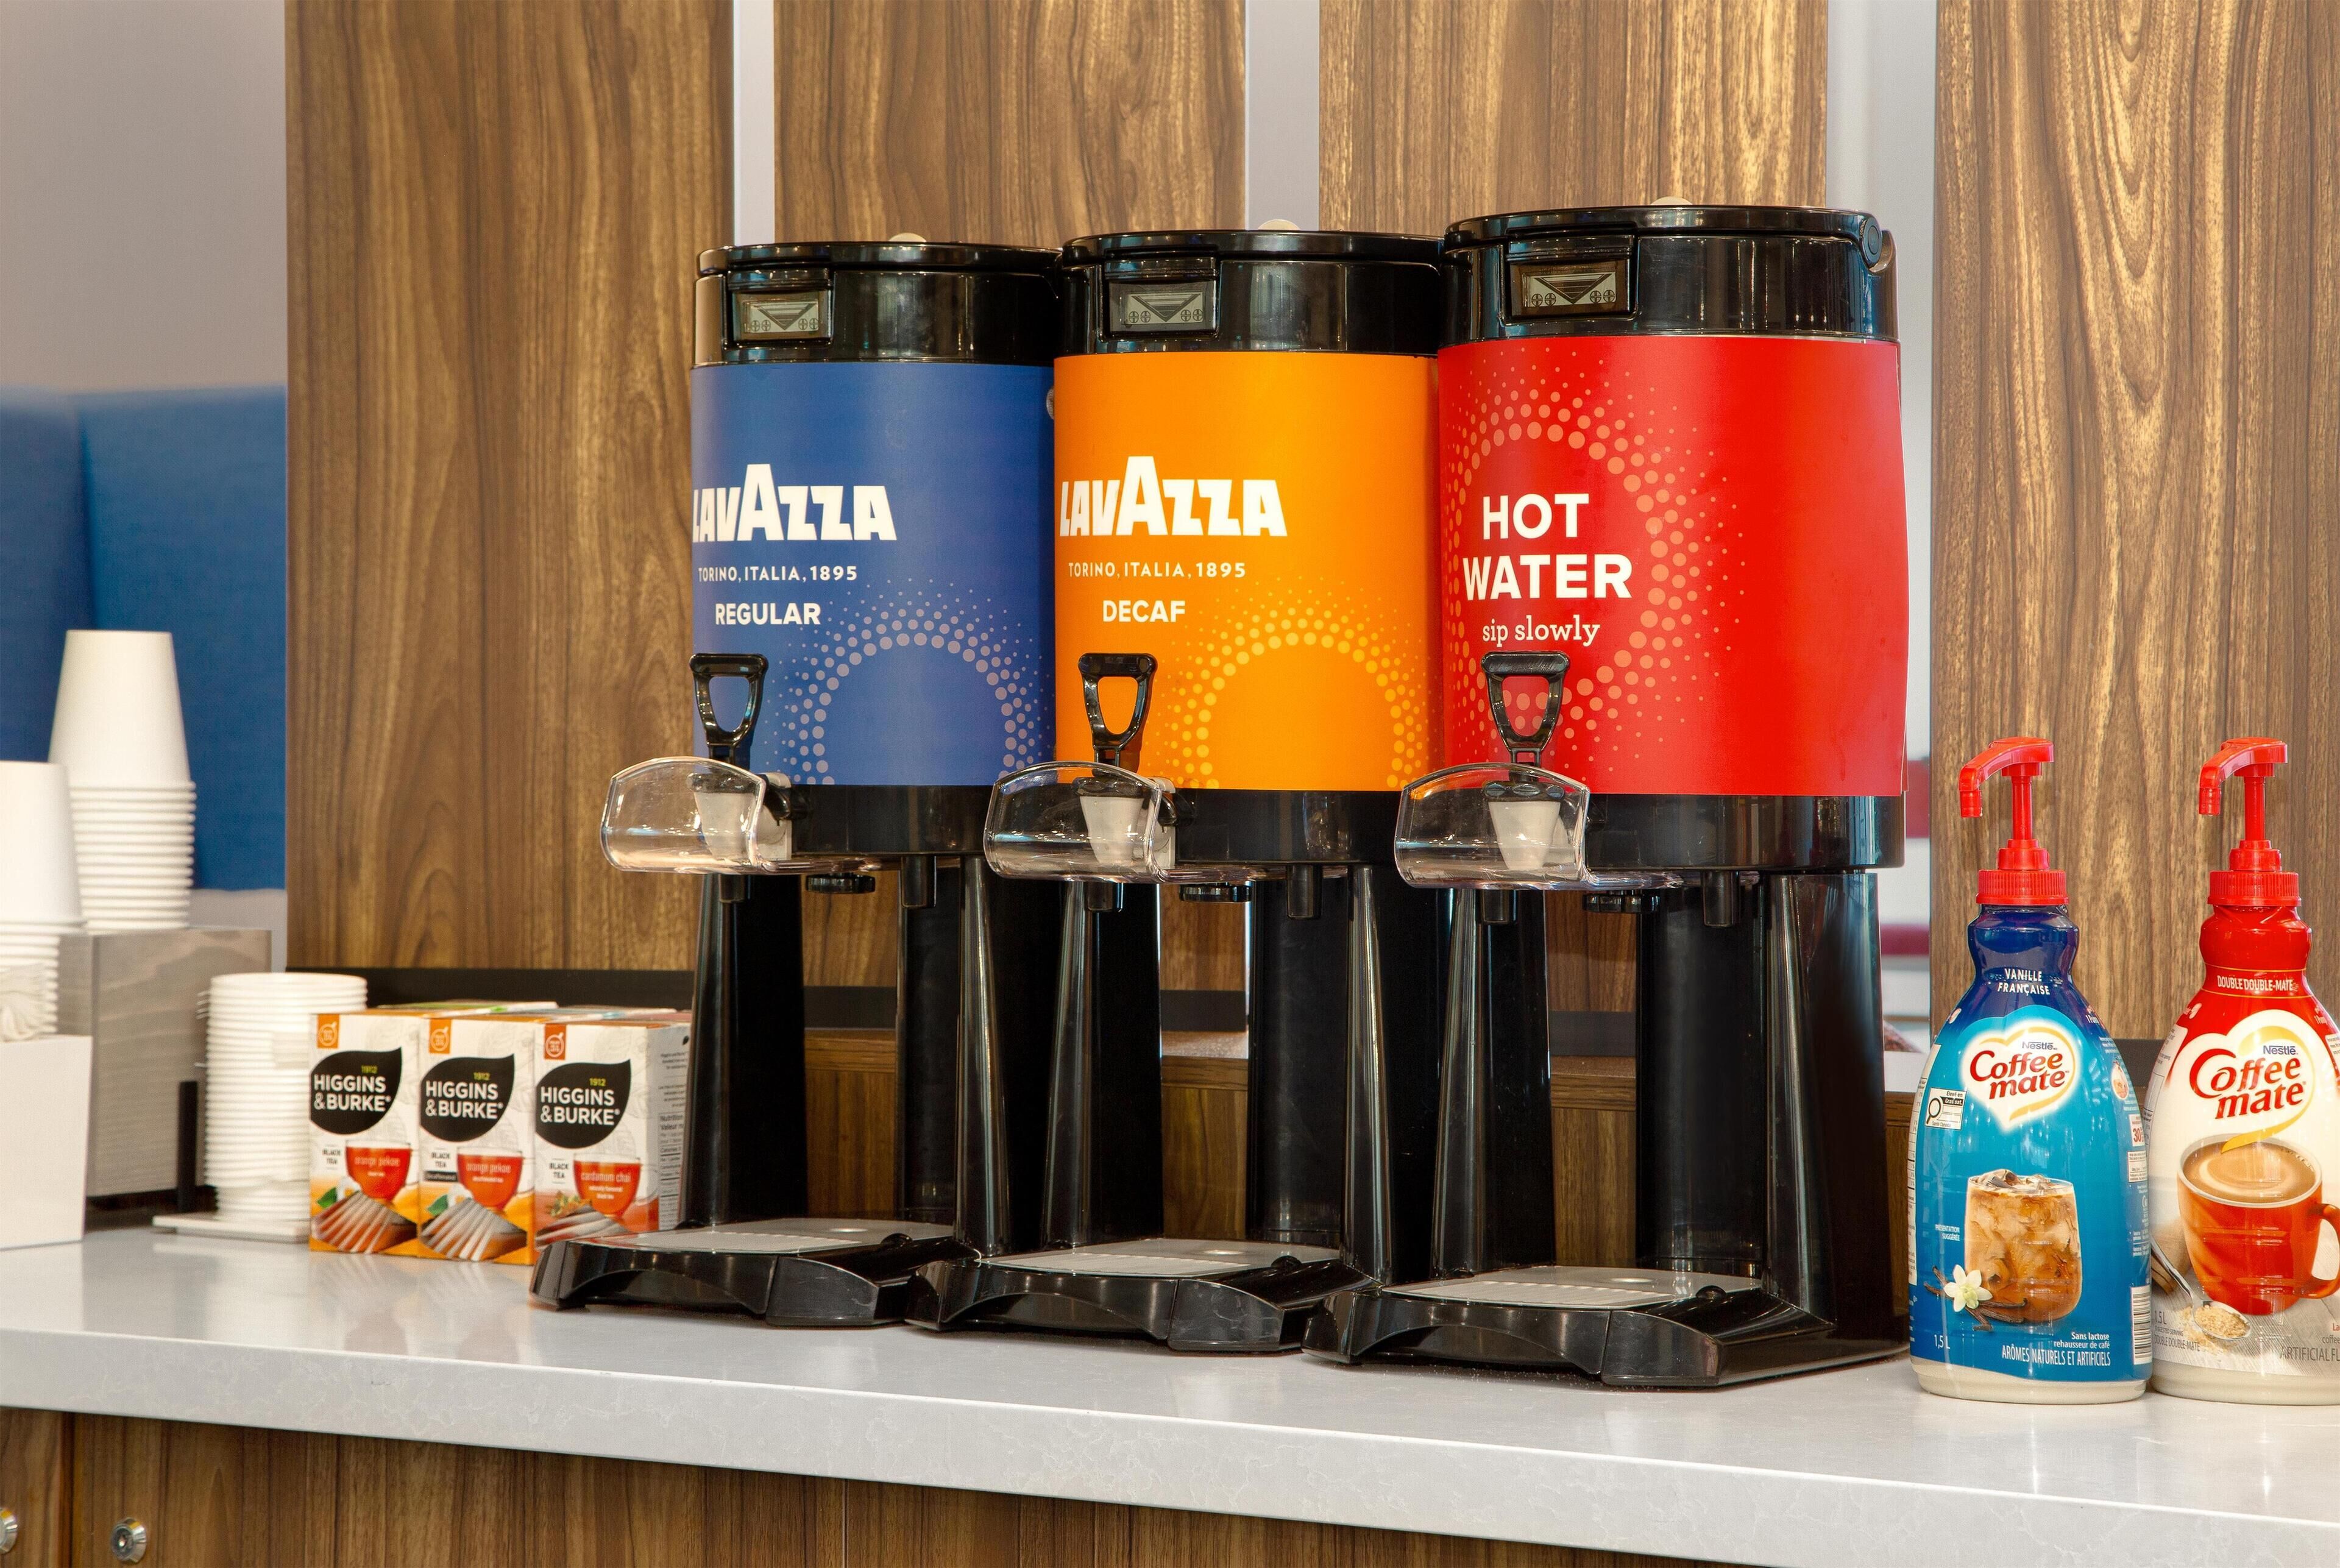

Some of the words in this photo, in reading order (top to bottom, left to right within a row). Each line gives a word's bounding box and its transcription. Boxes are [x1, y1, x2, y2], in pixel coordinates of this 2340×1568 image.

[692, 464, 897, 543] LAVAZZA
[1059, 456, 1287, 536] LAVAZZA
[1483, 493, 1589, 540] HOT
[698, 566, 741, 583] TORINO,
[745, 566, 807, 583] ITALIA,
[810, 566, 857, 581] 1895
[1068, 562, 1119, 580] TORINO,
[1124, 561, 1191, 579] ITALIA,
[1196, 562, 1246, 578] 1895
[1462, 554, 1633, 601] WATER
[715, 603, 821, 625] REGULAR
[1102, 600, 1186, 622] DECAF
[1483, 618, 1508, 647] sip
[1514, 614, 1600, 647] slowly
[2004, 968, 2042, 982] VANILLE
[2218, 975, 2243, 990] DOUBLE
[2244, 979, 2293, 991] DOUBLE-MATE
[1998, 982, 2051, 996] FRANÇAISE
[1970, 1049, 2063, 1082] Coffee
[2189, 1048, 2301, 1099] Coffee
[314, 1074, 386, 1093] HIGGINS
[426, 1080, 498, 1100] HIGGINS
[589, 1077, 606, 1087] 1912
[1988, 1070, 2066, 1100] mate
[541, 1087, 615, 1106] HIGGINS
[2215, 1083, 2303, 1119] mate
[2054, 1340, 2088, 1349] rehausseur
[2088, 1332, 2110, 1341] lactose
[2002, 1344, 2029, 1362] ARÔMES
[2032, 1348, 2065, 1365] NATURELS
[2067, 1351, 2075, 1365] ET
[2077, 1352, 2111, 1366] ARTIFICIELS
[2279, 1346, 2330, 1361] ARTIFICIAL
